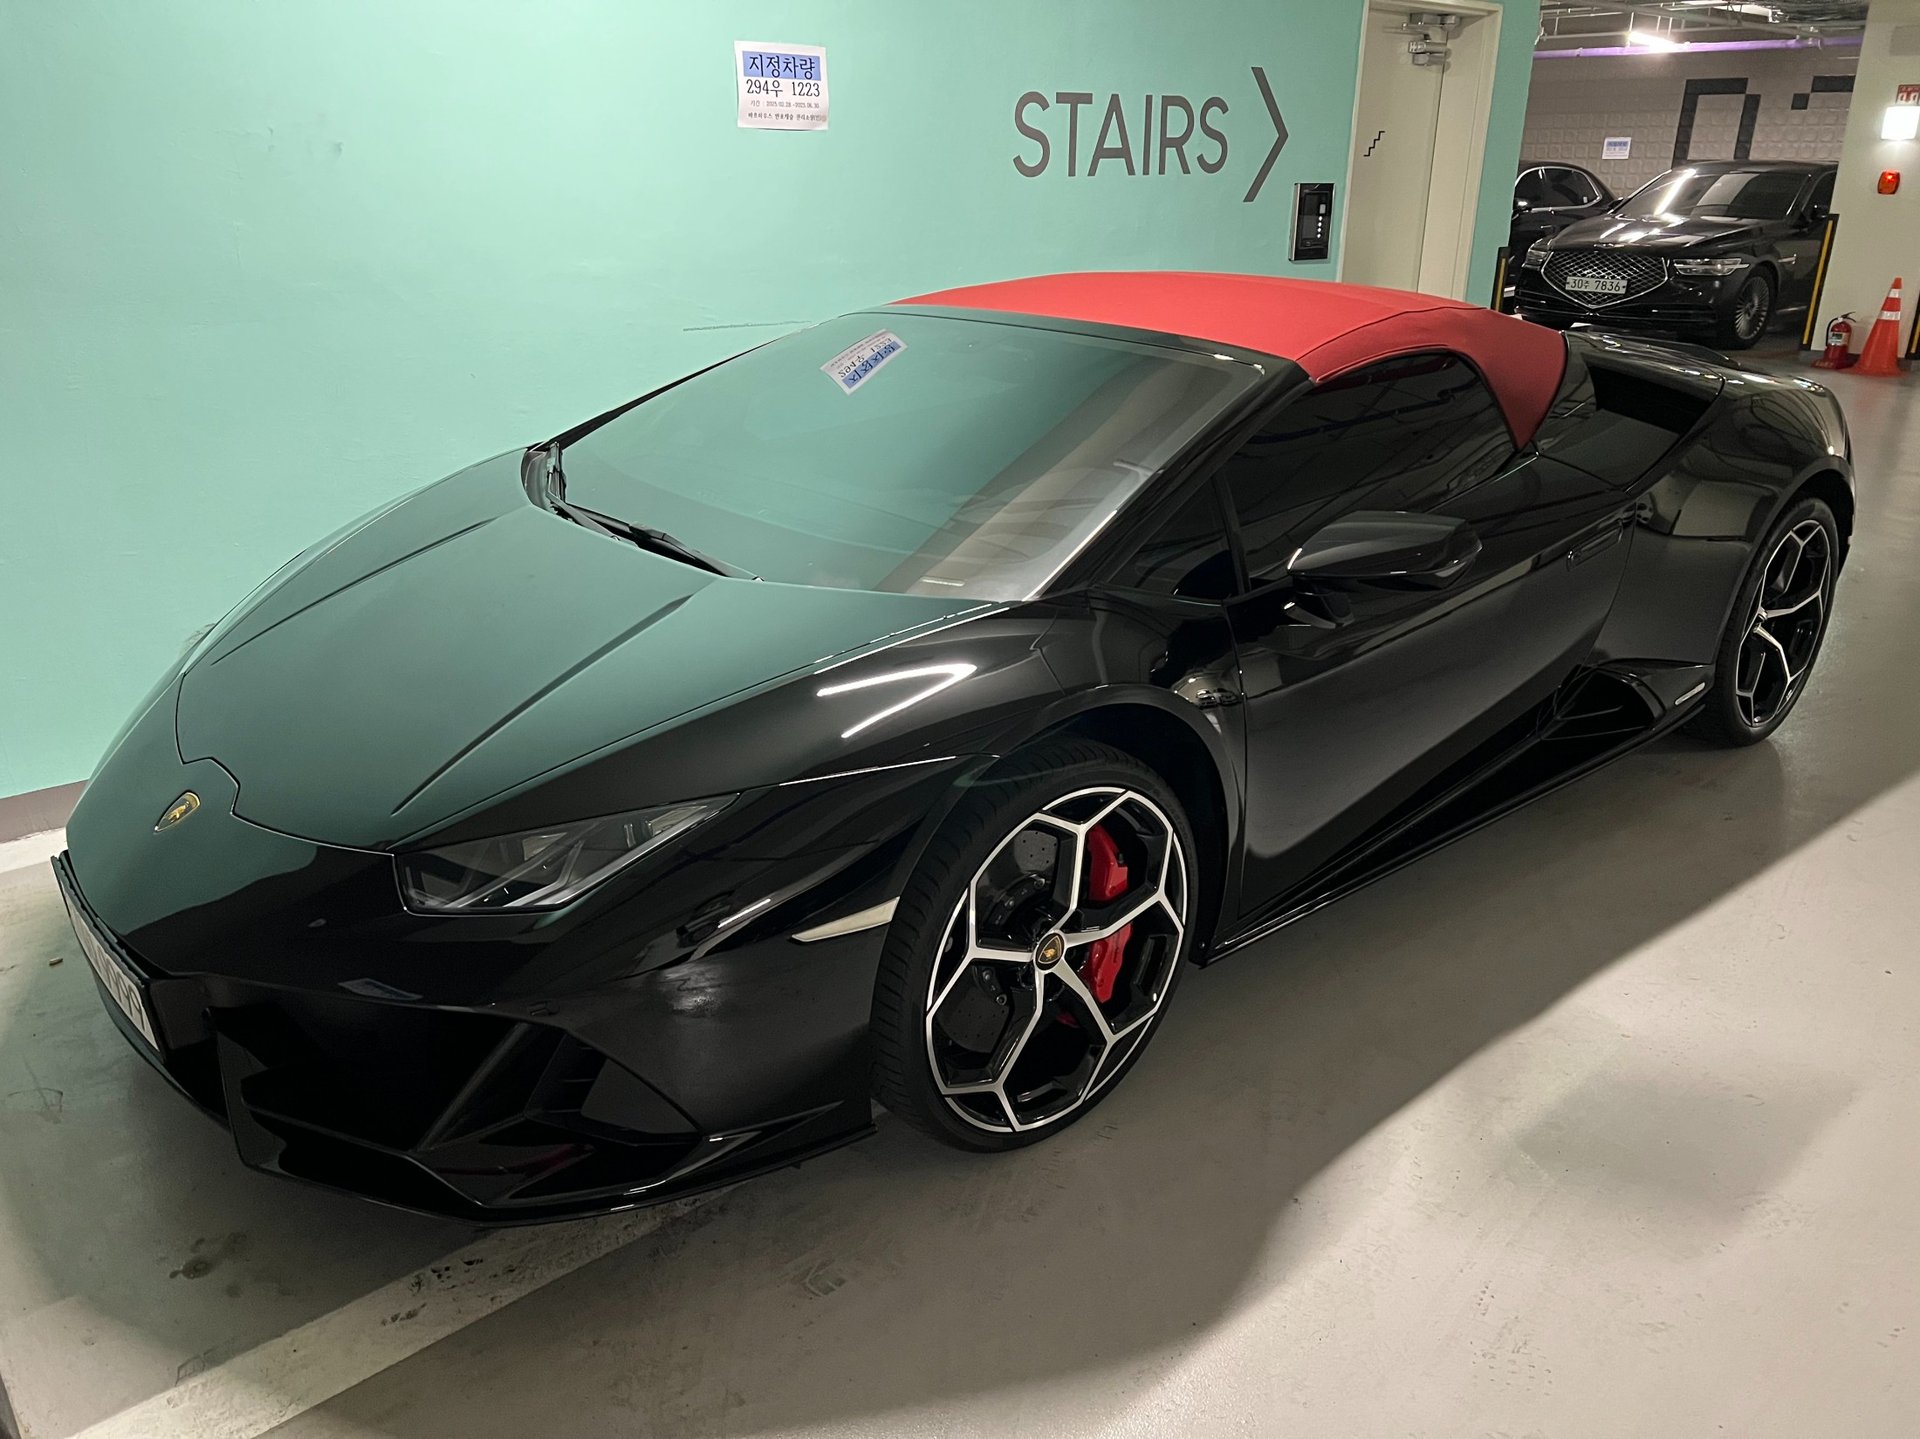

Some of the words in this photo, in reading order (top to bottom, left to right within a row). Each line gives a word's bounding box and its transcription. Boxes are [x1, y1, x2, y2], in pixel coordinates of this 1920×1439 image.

[749, 54, 816, 80] 지정차량
[746, 79, 783, 97] 294우
[791, 81, 820, 97] 1223
[1012, 91, 1230, 177] STAIRS
[1595, 280, 1621, 292] 7836
